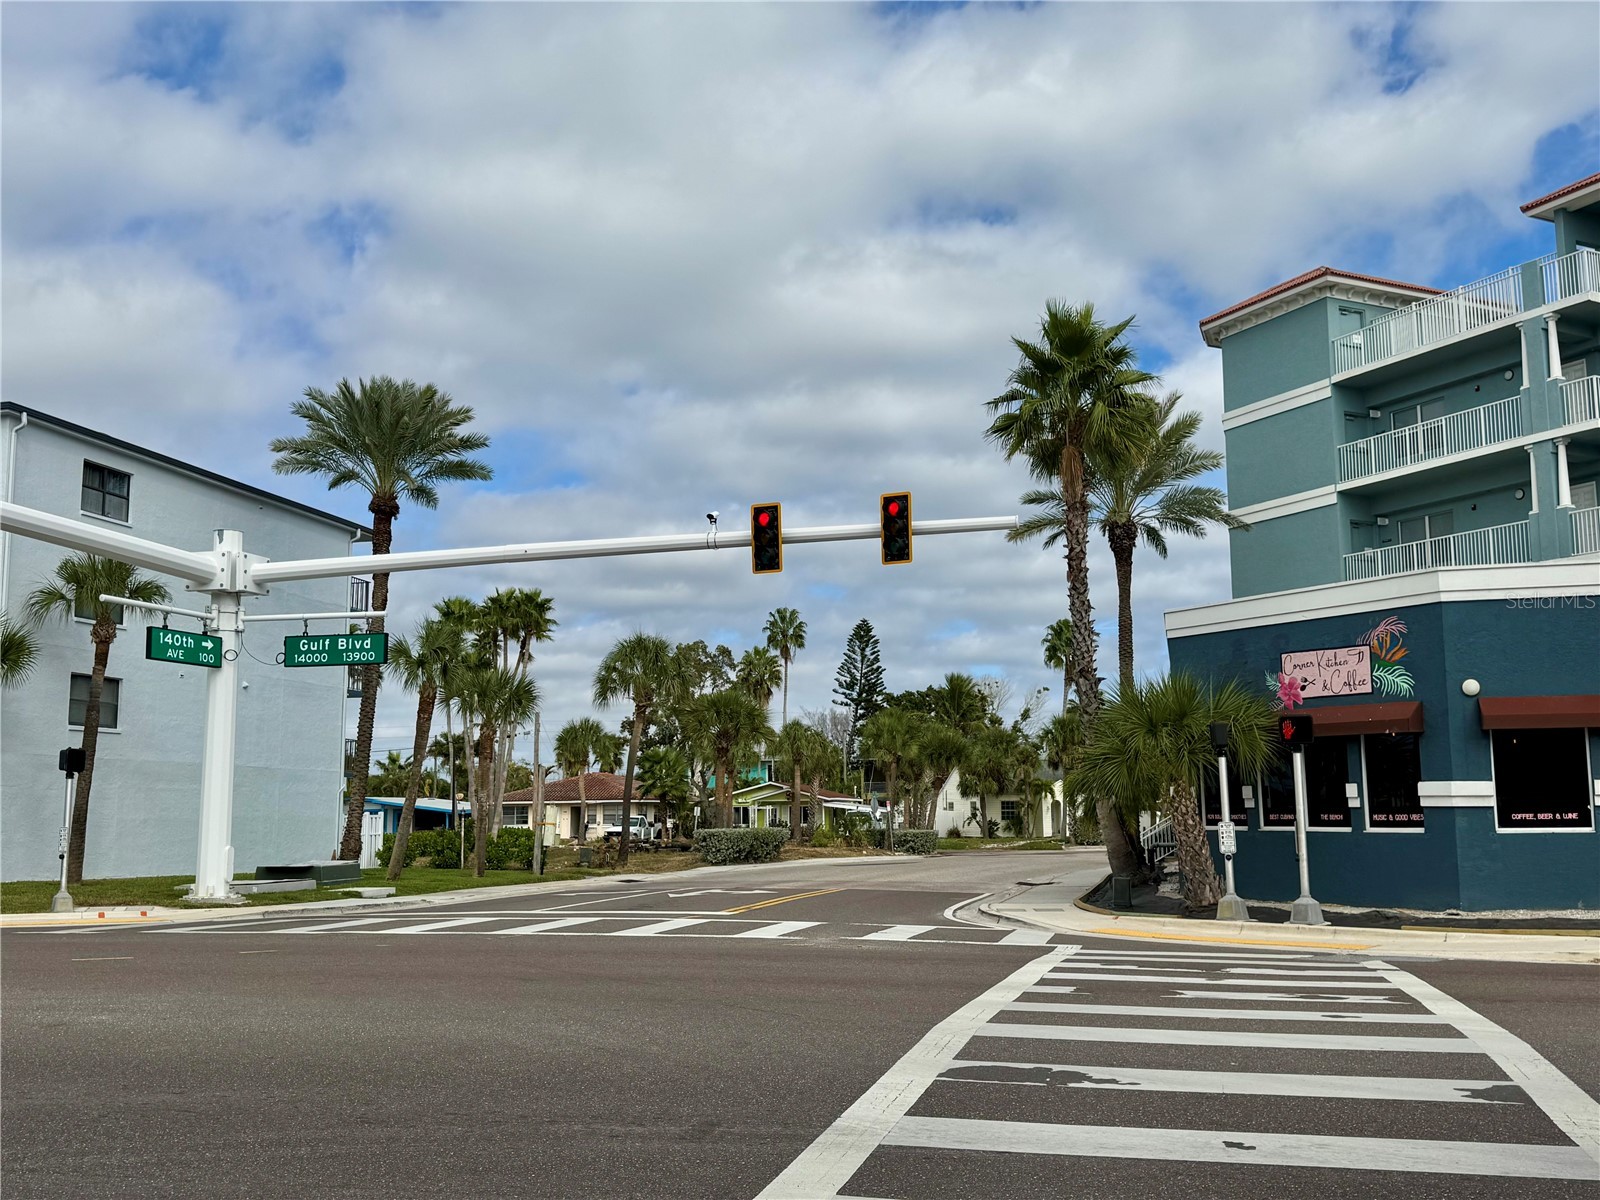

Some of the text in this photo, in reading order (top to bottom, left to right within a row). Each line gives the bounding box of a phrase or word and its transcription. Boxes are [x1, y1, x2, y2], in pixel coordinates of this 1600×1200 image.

[159, 632, 194, 648] 140th
[300, 638, 371, 651] Gulf Blvd
[166, 648, 215, 663] AVE 100
[294, 653, 328, 663] 14000
[343, 651, 376, 662] 13900
[1283, 650, 1349, 678] Corner Kitchen
[1321, 668, 1369, 695] & Coffee
[1394, 813, 1409, 821] GOOD
[1410, 813, 1425, 821] VIBES
